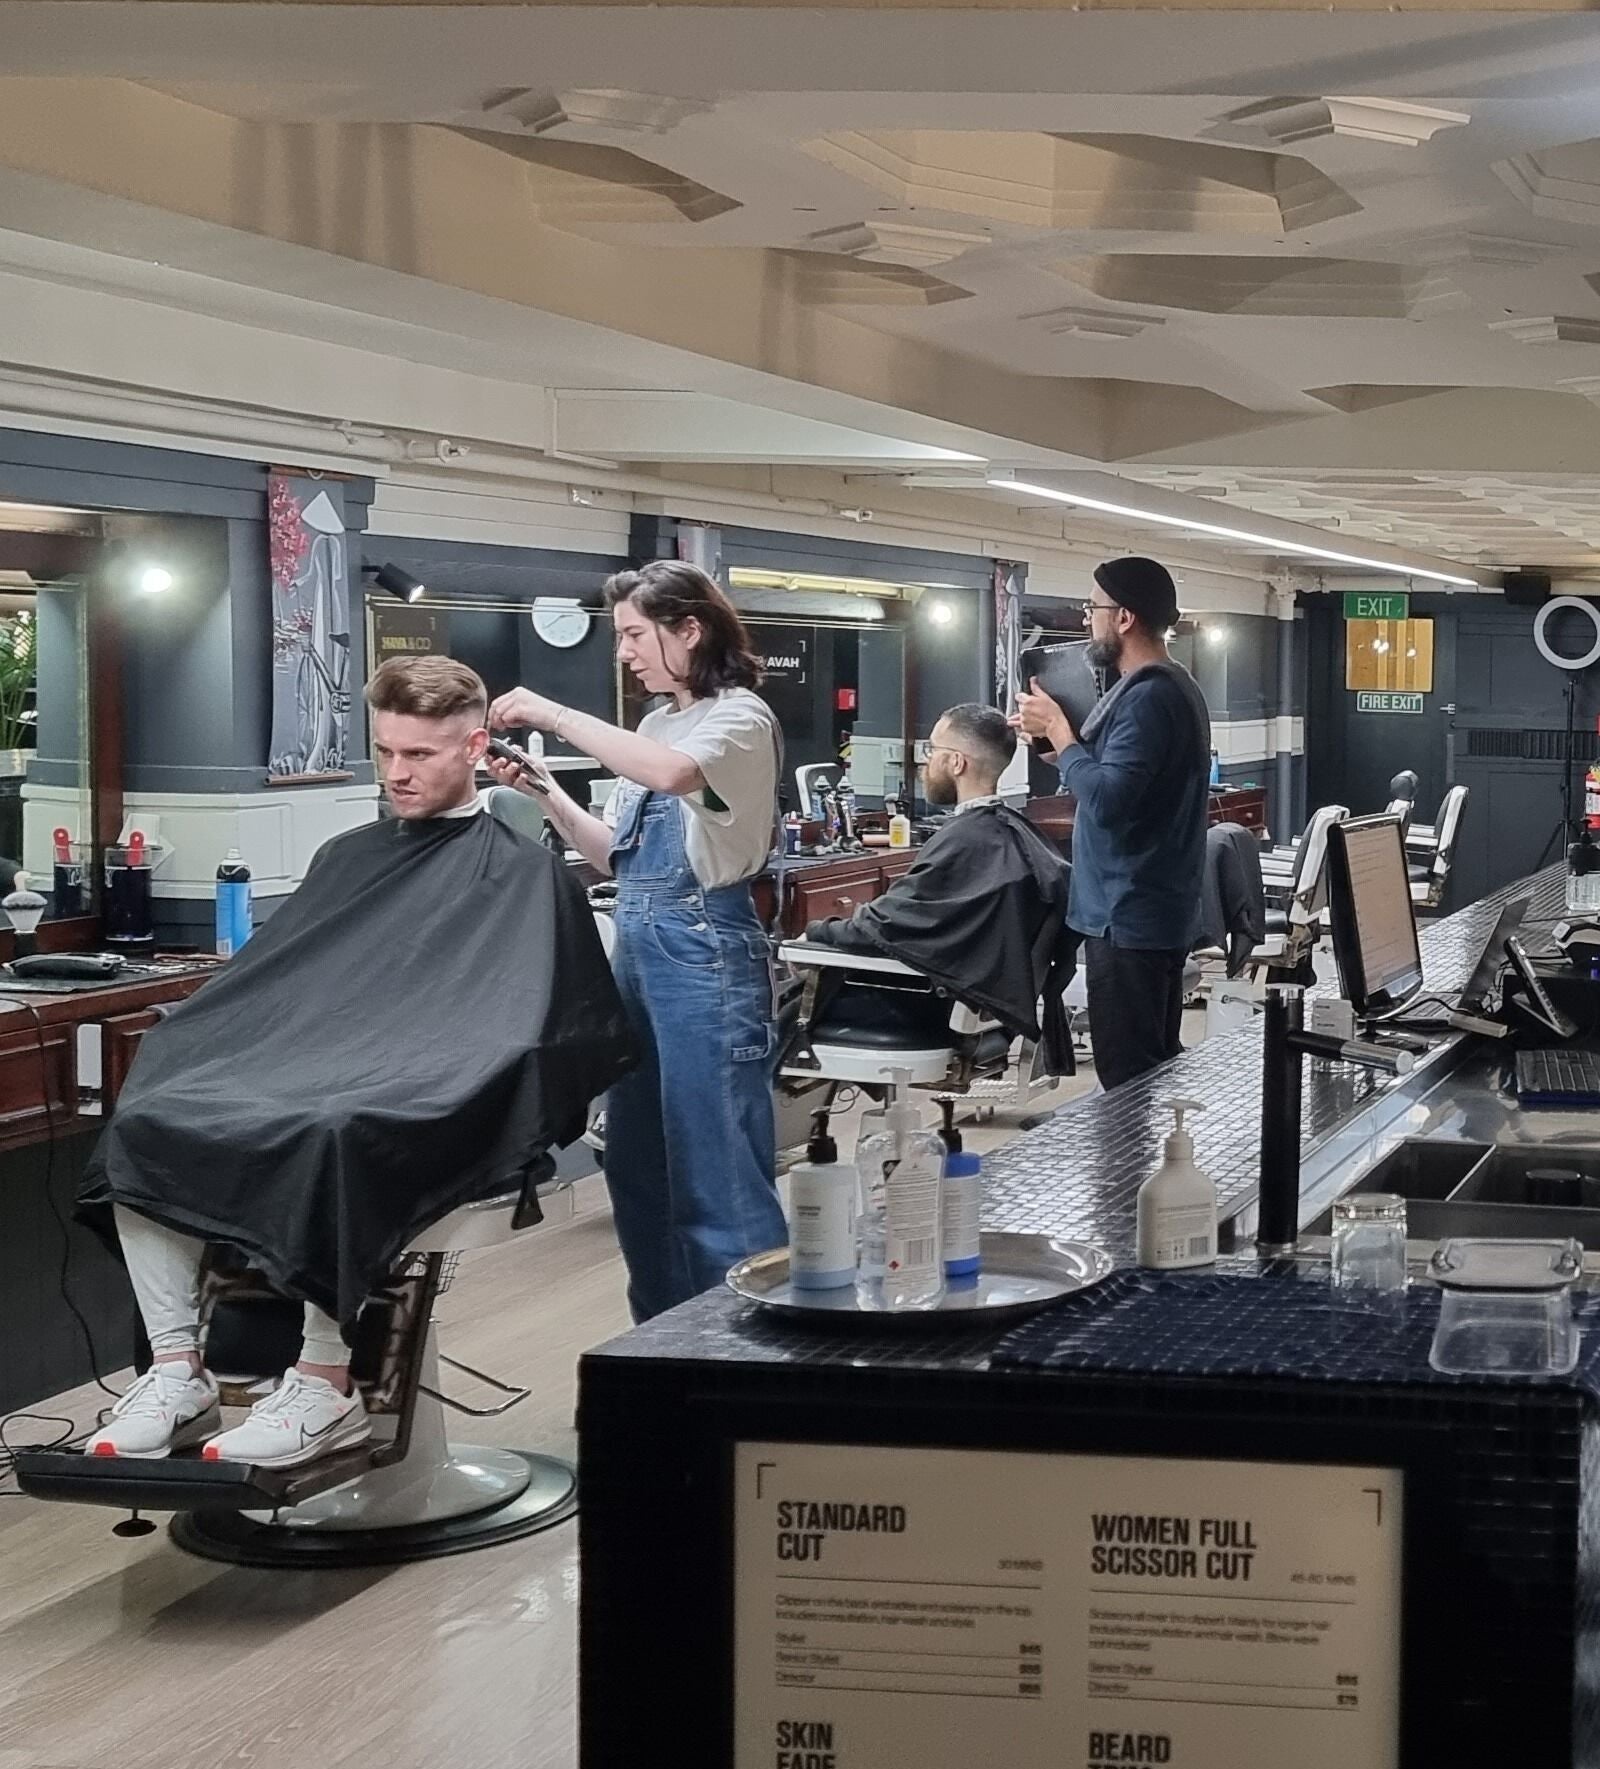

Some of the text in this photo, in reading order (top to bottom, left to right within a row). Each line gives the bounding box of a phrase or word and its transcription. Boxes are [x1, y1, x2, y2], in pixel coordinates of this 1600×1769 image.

[1357, 597, 1392, 616] EXIT
[1361, 695, 1418, 710] FIRE EXIT
[777, 1500, 906, 1533] STANDARD
[1091, 1514, 1257, 1549] WOMEN FULL
[777, 1533, 824, 1561] CUT
[1091, 1546, 1254, 1581] SCISSOR CUT
[776, 1720, 833, 1749] SKIN
[1088, 1731, 1172, 1764] BEARD
